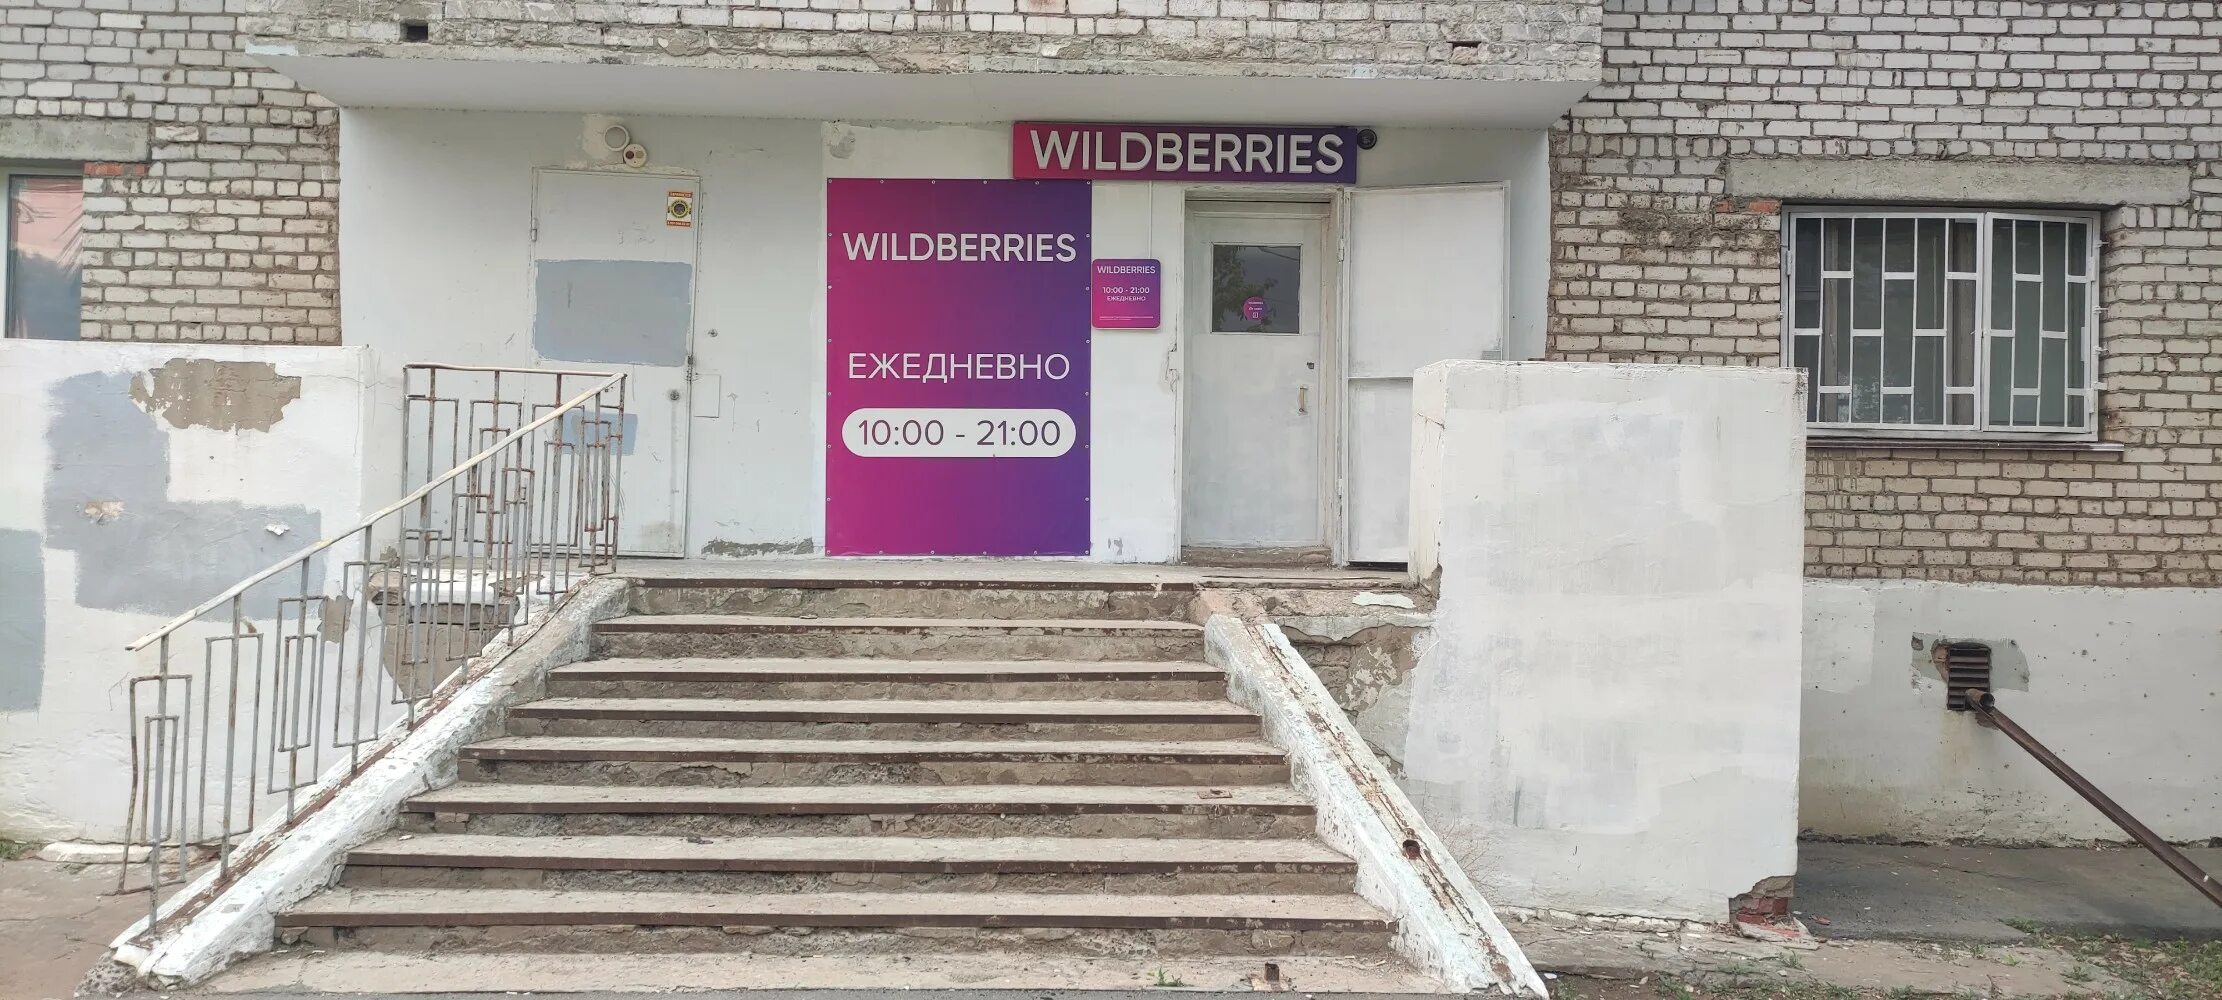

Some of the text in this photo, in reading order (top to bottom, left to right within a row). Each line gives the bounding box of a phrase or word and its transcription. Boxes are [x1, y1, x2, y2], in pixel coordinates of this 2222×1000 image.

[1030, 129, 1344, 174] WILDBERRIES
[842, 232, 1077, 262] WILDBERRIES
[1097, 265, 1156, 274] WILDBERRIES
[1102, 286, 1124, 294] 10:00
[1130, 286, 1150, 294] 21:00
[848, 353, 1070, 383] ЕЖЕДНЕВНО
[858, 419, 944, 446] 10:00
[976, 420, 1061, 446] 21:00
